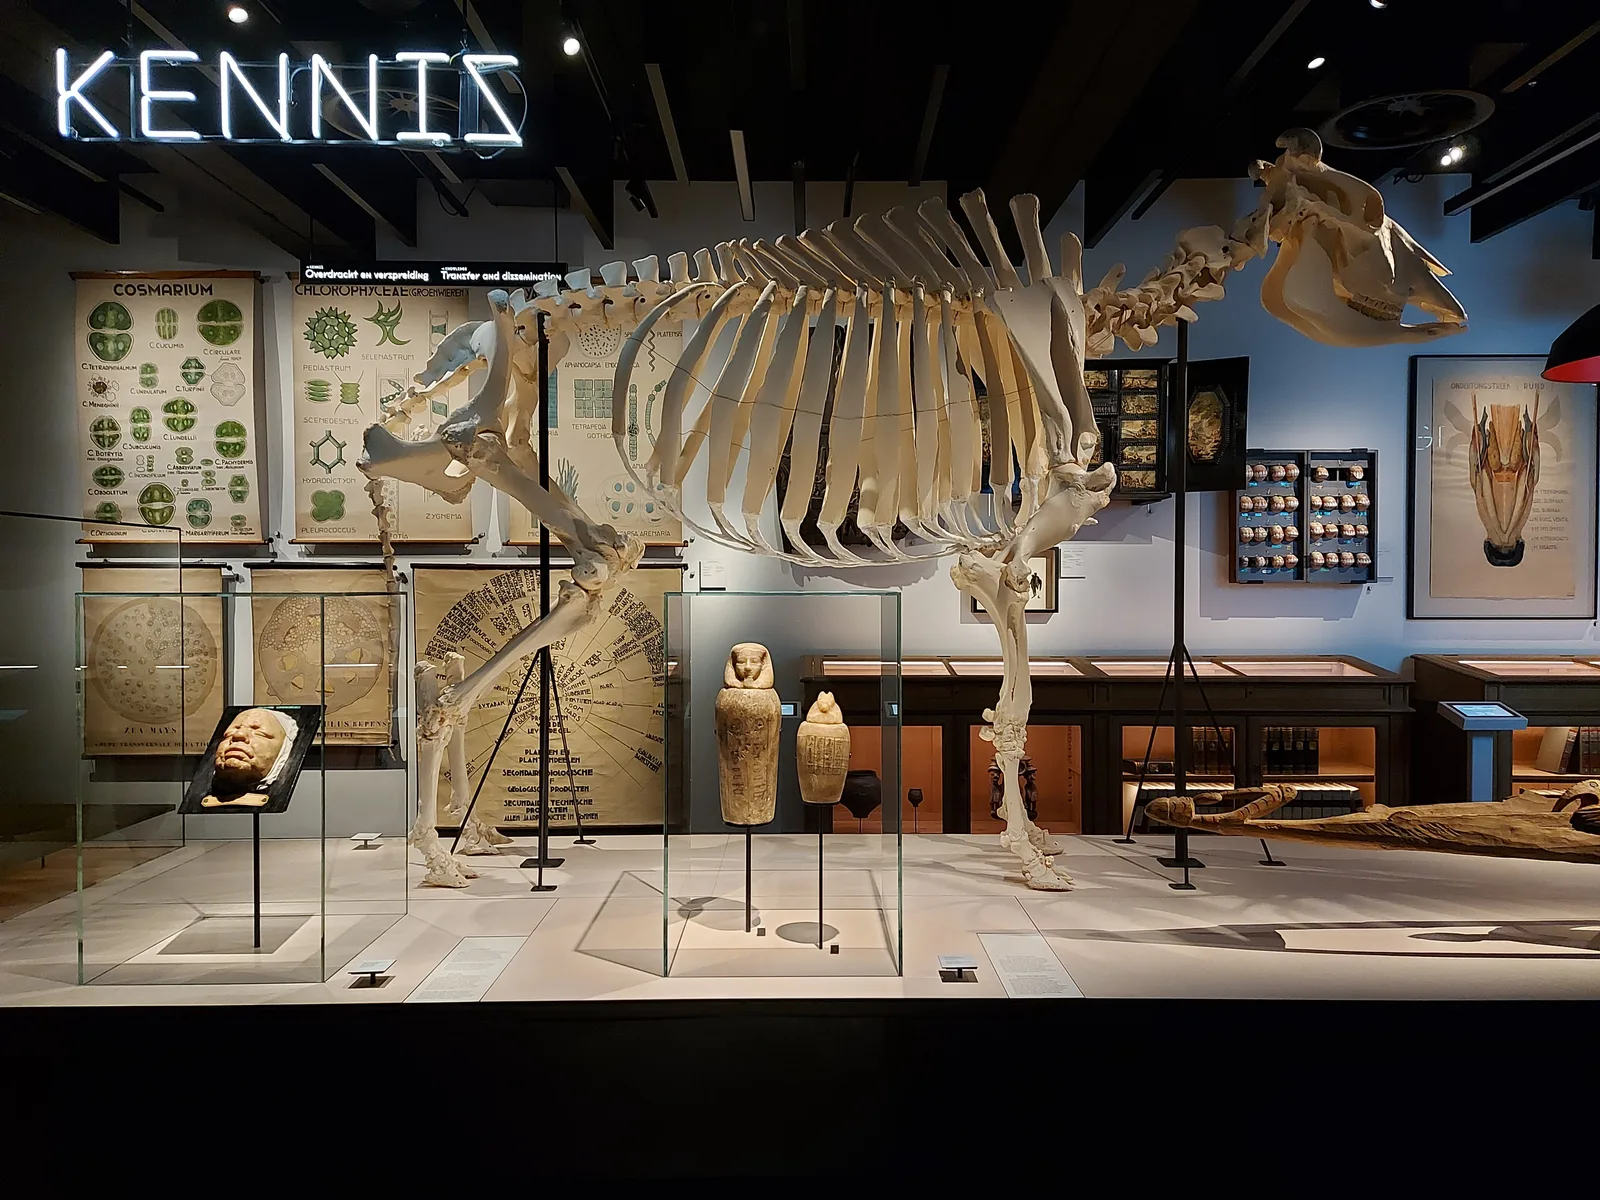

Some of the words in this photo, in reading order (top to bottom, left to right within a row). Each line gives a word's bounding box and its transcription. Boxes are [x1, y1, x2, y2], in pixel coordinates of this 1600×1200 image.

[56, 47, 523, 144] KENNIS
[305, 269, 359, 279] Overdracht
[374, 270, 430, 282] verspreiding
[440, 270, 480, 281] Transfer
[482, 271, 500, 281] and
[502, 271, 562, 282] dissemination
[113, 283, 213, 297] COSMARIUM
[302, 364, 352, 372] PEDIASTRUM
[303, 416, 359, 425] SCENEDESMUS
[301, 526, 357, 534] PLEUROCOCCUS
[613, 635, 626, 646] TURF
[564, 707, 582, 722] HARS
